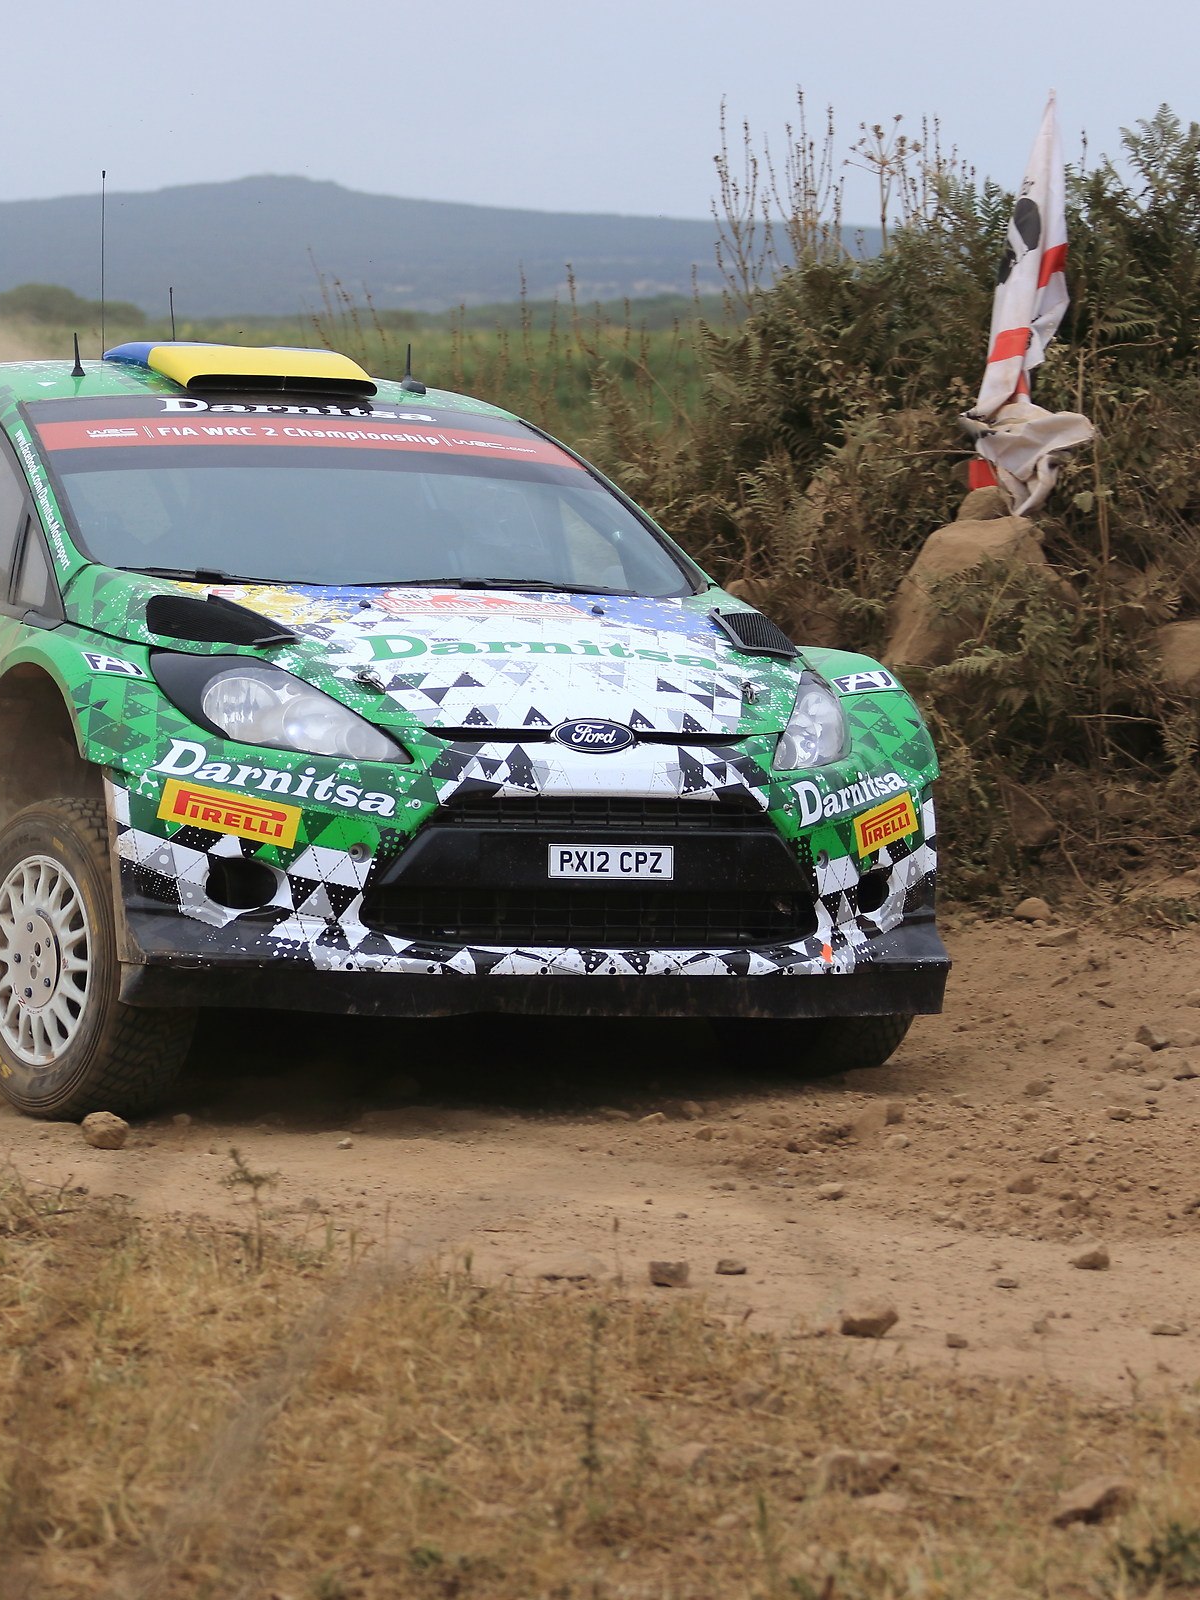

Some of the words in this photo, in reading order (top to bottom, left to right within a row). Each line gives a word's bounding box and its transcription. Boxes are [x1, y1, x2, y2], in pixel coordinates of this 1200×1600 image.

[156, 397, 437, 422] Darnitsa
[157, 426, 197, 437] FIA
[201, 426, 257, 437] WRC
[261, 427, 279, 437] 2
[283, 427, 440, 446] Championship
[14, 428, 71, 572] www.facebook.com/Darnitsa.Motorsport
[354, 634, 724, 672] Darnitsa
[570, 724, 617, 745] Ford
[150, 738, 397, 818] Darnitsa
[790, 770, 908, 828] Darnitsa
[173, 789, 288, 838] PIRELLI
[860, 802, 911, 848] PIRELLI
[559, 850, 610, 873] PX12
[619, 851, 663, 874] CPZ
